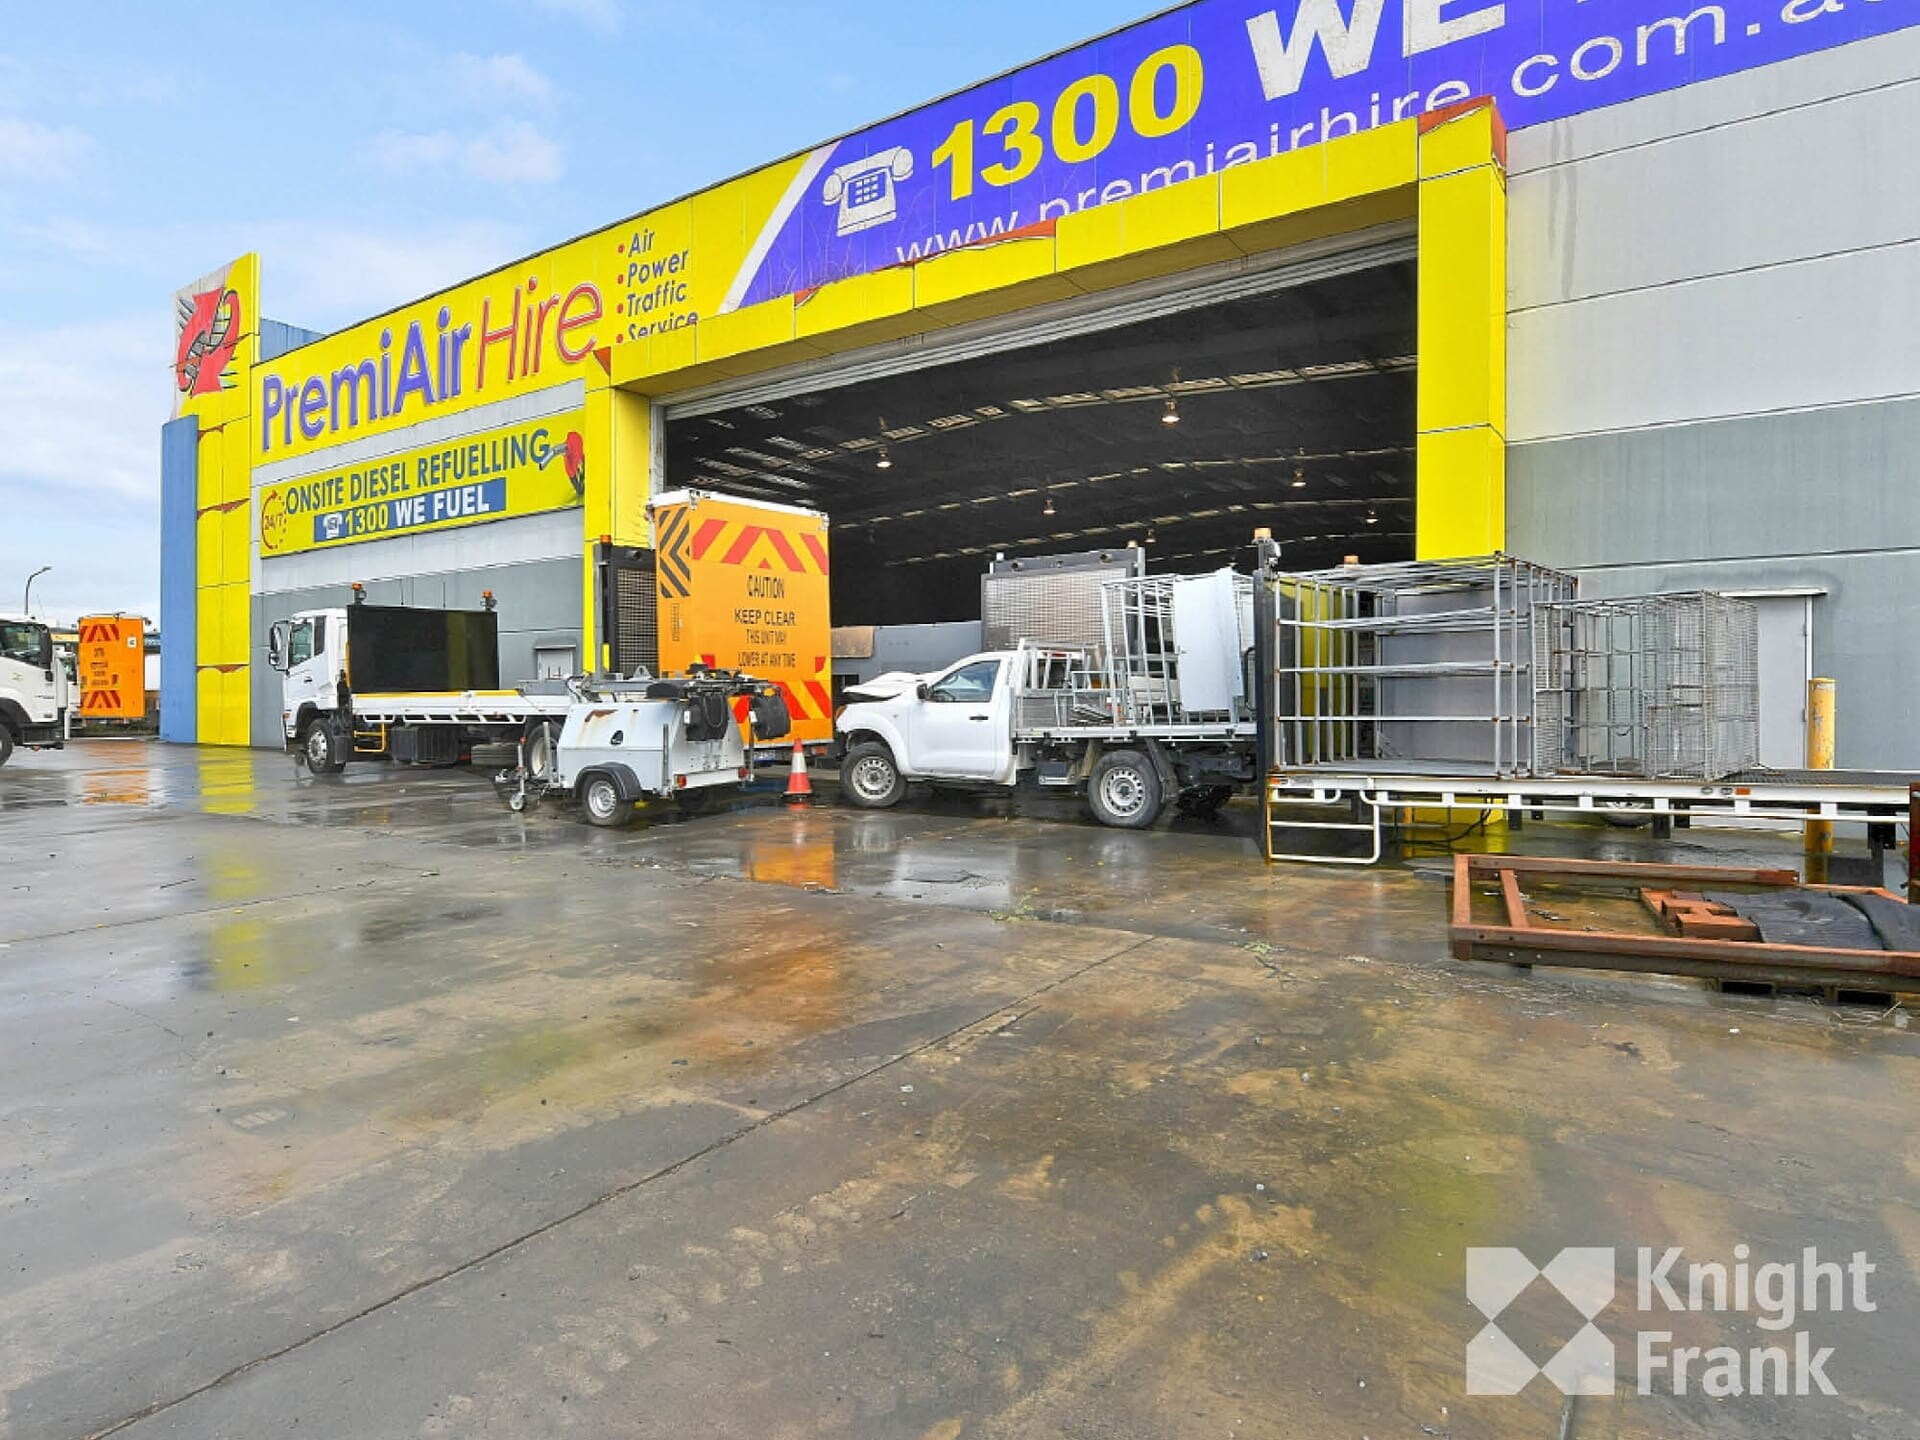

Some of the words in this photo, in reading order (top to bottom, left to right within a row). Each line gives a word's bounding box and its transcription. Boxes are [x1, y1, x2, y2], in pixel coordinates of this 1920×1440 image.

[931, 44, 1204, 201] 1300
[628, 228, 655, 258] Air
[627, 250, 689, 287] Power
[627, 280, 687, 317] Traffic
[286, 476, 344, 515] ONSITE
[350, 461, 410, 501] DIESEL
[416, 429, 550, 488] REFUELLING
[264, 512, 284, 531] 24/7
[345, 504, 388, 537] 1300
[395, 498, 425, 526] WE
[433, 485, 490, 521] FUEL
[747, 574, 785, 599] CAUTION
[734, 607, 762, 625] KEEP
[764, 610, 796, 626] CLEAR
